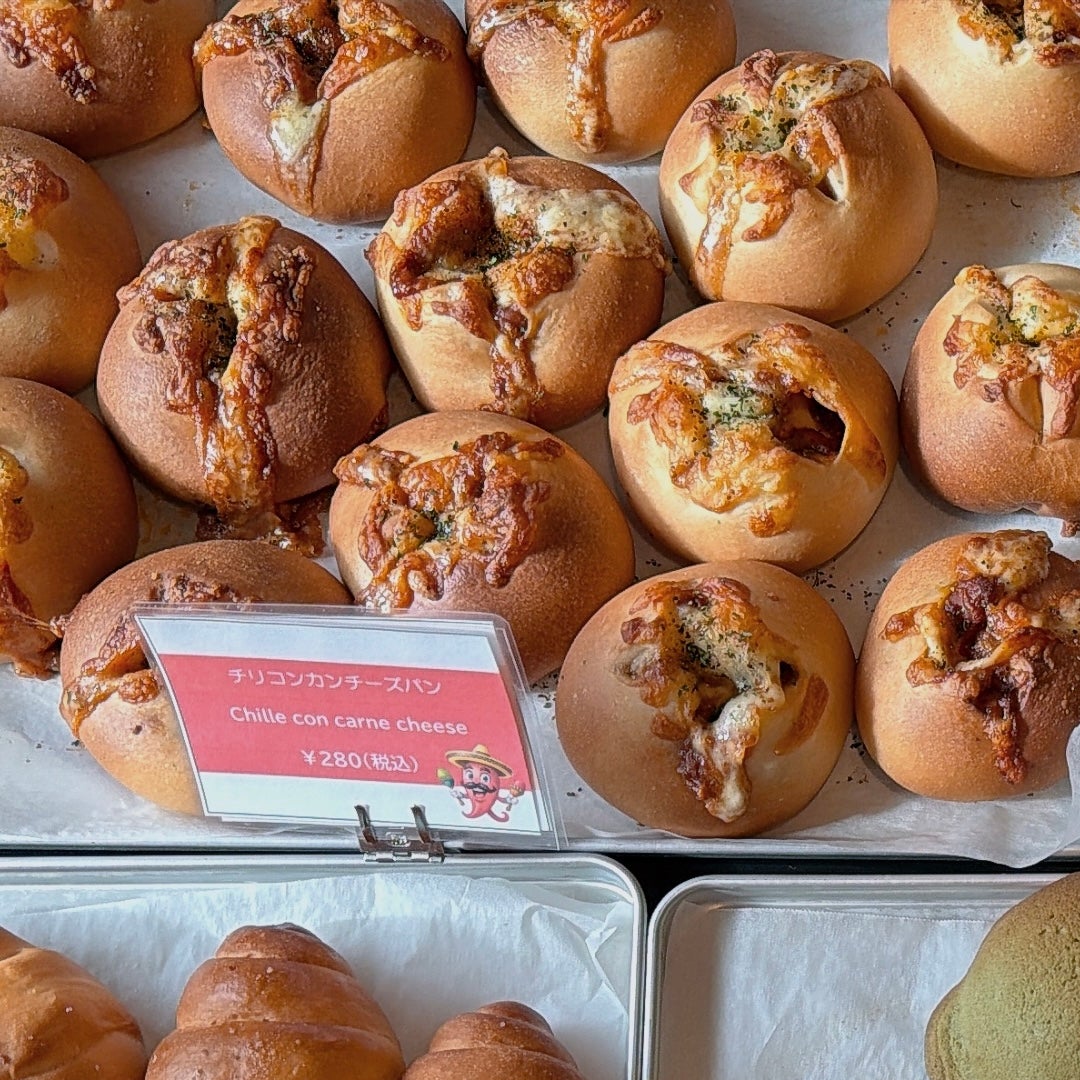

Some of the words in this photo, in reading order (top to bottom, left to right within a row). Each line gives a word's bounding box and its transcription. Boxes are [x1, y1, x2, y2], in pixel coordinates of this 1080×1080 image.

[227, 668, 442, 695] チリコンカンチーズパン
[229, 706, 287, 725] Chille
[292, 712, 329, 728] con
[334, 716, 390, 731] carne
[396, 717, 468, 736] cheese
